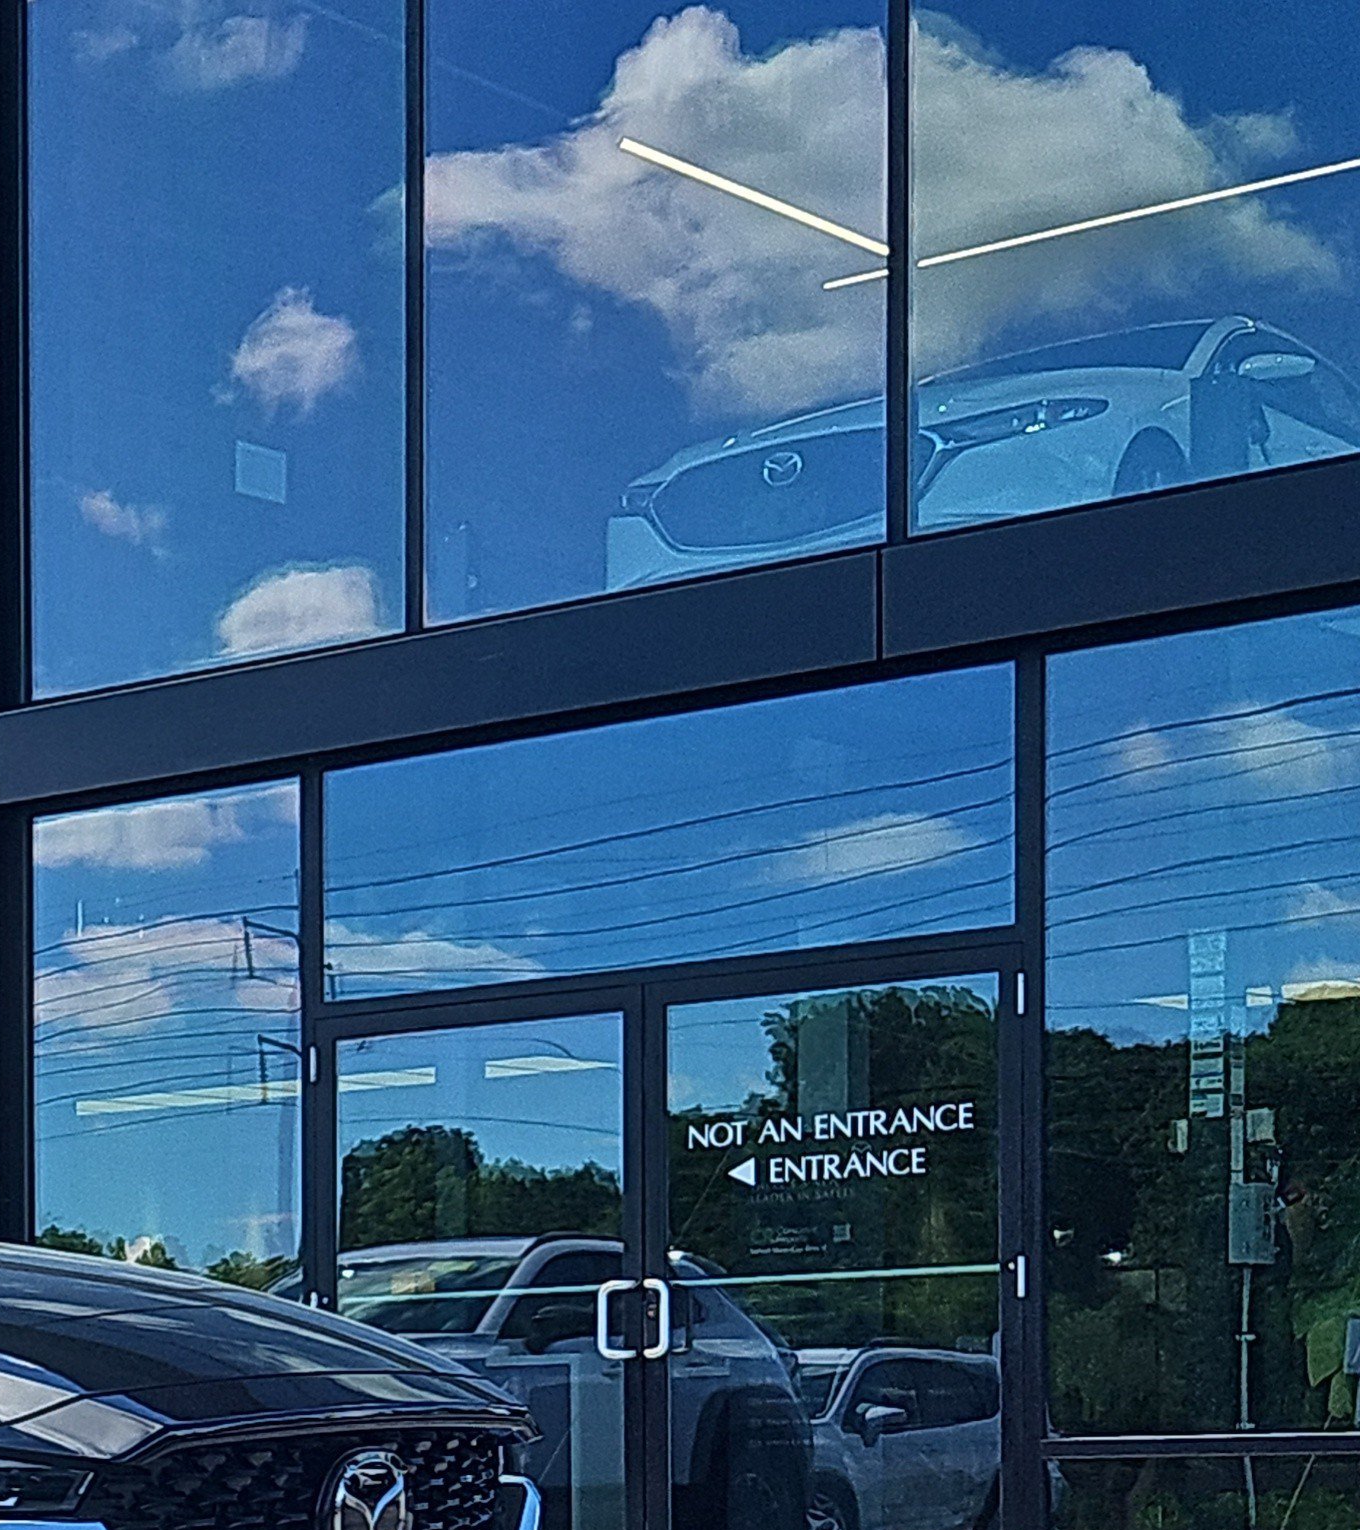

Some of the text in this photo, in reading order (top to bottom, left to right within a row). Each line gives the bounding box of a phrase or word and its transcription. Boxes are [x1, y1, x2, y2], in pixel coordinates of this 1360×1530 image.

[687, 1102, 975, 1150] NOT AN ENTRANCE
[769, 1147, 926, 1184] ENTRANCE
